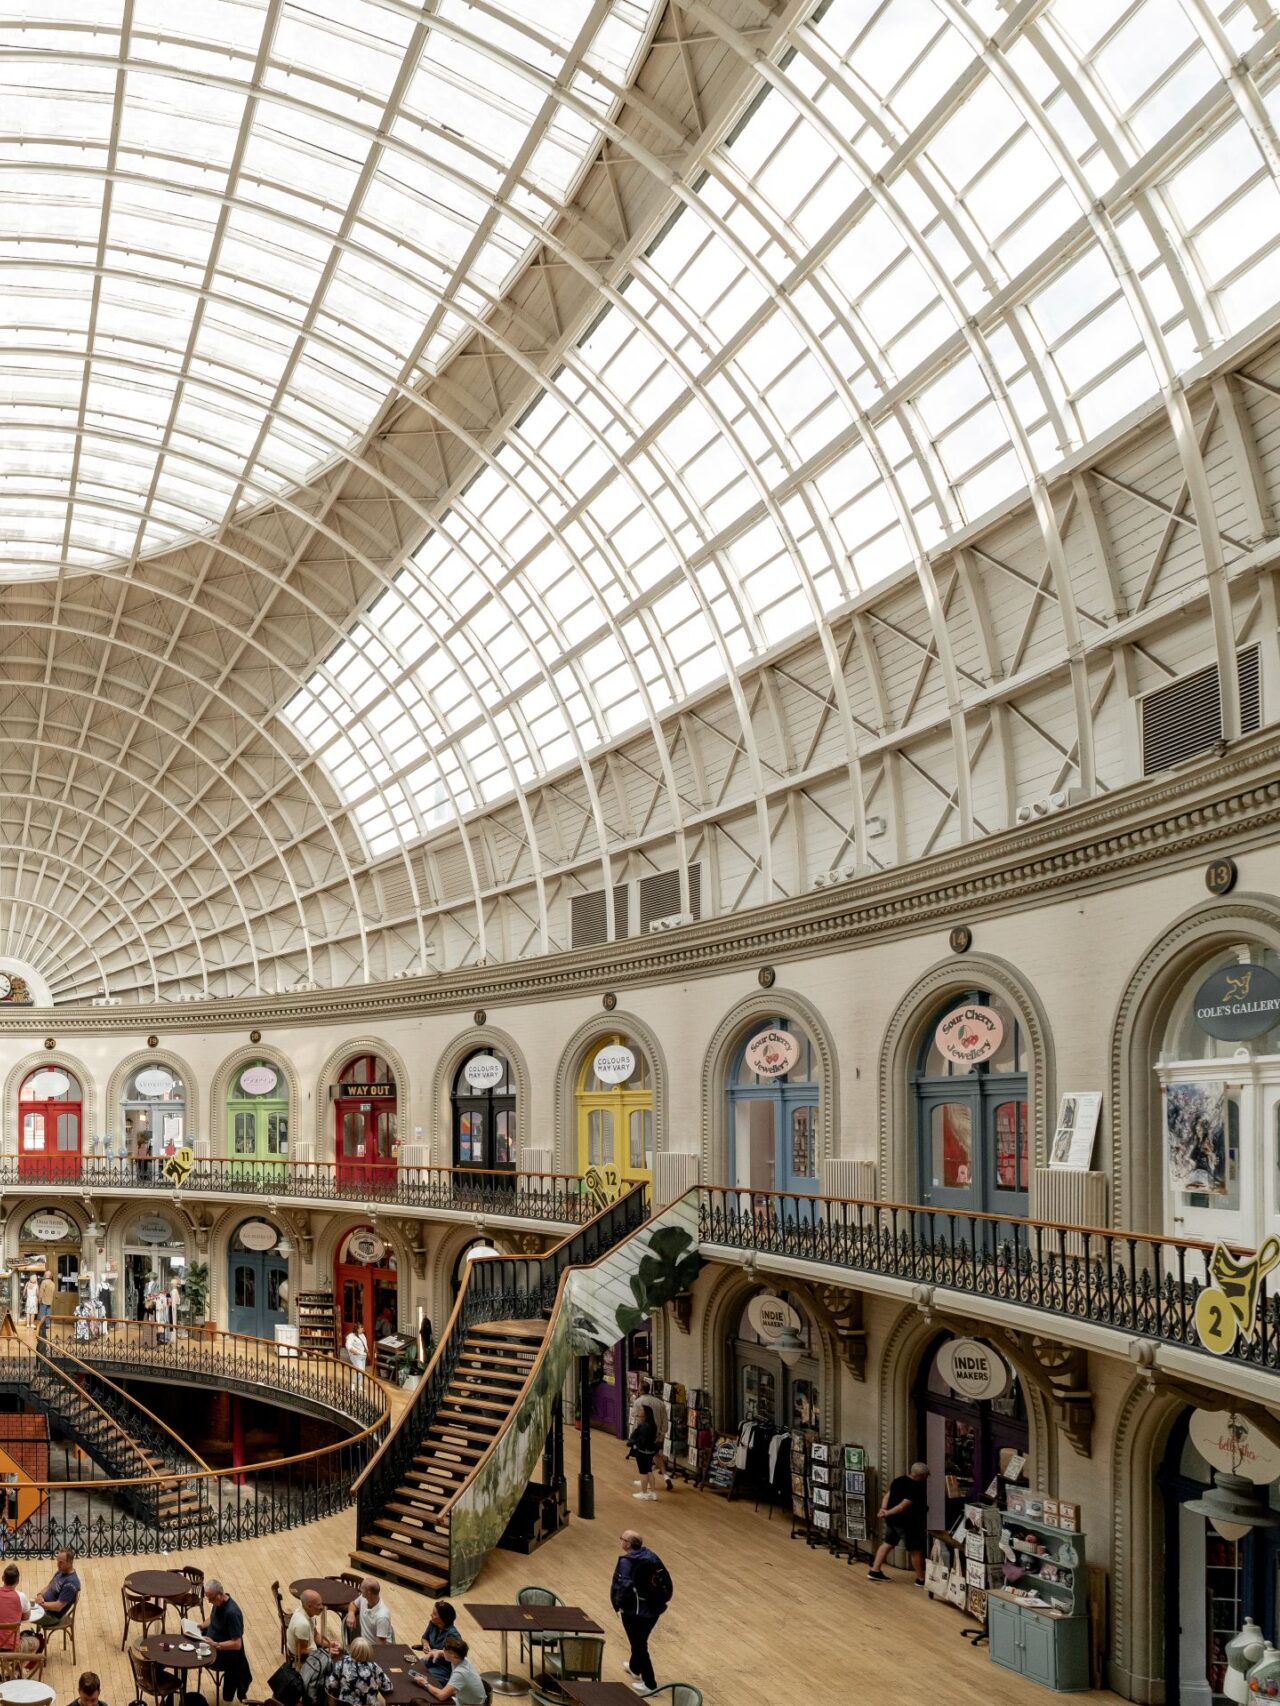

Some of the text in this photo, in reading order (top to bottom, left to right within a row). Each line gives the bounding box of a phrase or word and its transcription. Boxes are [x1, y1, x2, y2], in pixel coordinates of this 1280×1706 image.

[1210, 866, 1228, 886] 13
[952, 931, 965, 946] 14
[761, 970, 771, 983] 15
[604, 996, 613, 1006] 16
[1197, 999, 1280, 1018] COLE'S GALLERY
[942, 1009, 996, 1034] Sour Cherry
[750, 1032, 792, 1052] Sour Cherry
[947, 1039, 992, 1060] Jewellery
[598, 1056, 630, 1066] COLOURS
[612, 1064, 630, 1072] VARY
[754, 1057, 790, 1074] Jewellery
[348, 1086, 390, 1096] WAY OUT
[182, 1152, 190, 1162] 11
[605, 1172, 617, 1186] 12
[762, 1310, 784, 1322] INDIE
[1208, 1305, 1222, 1338] 2
[954, 1356, 988, 1370] INDIE
[124, 1365, 150, 1376] SHAPES
[956, 1371, 988, 1381] MAKERS
